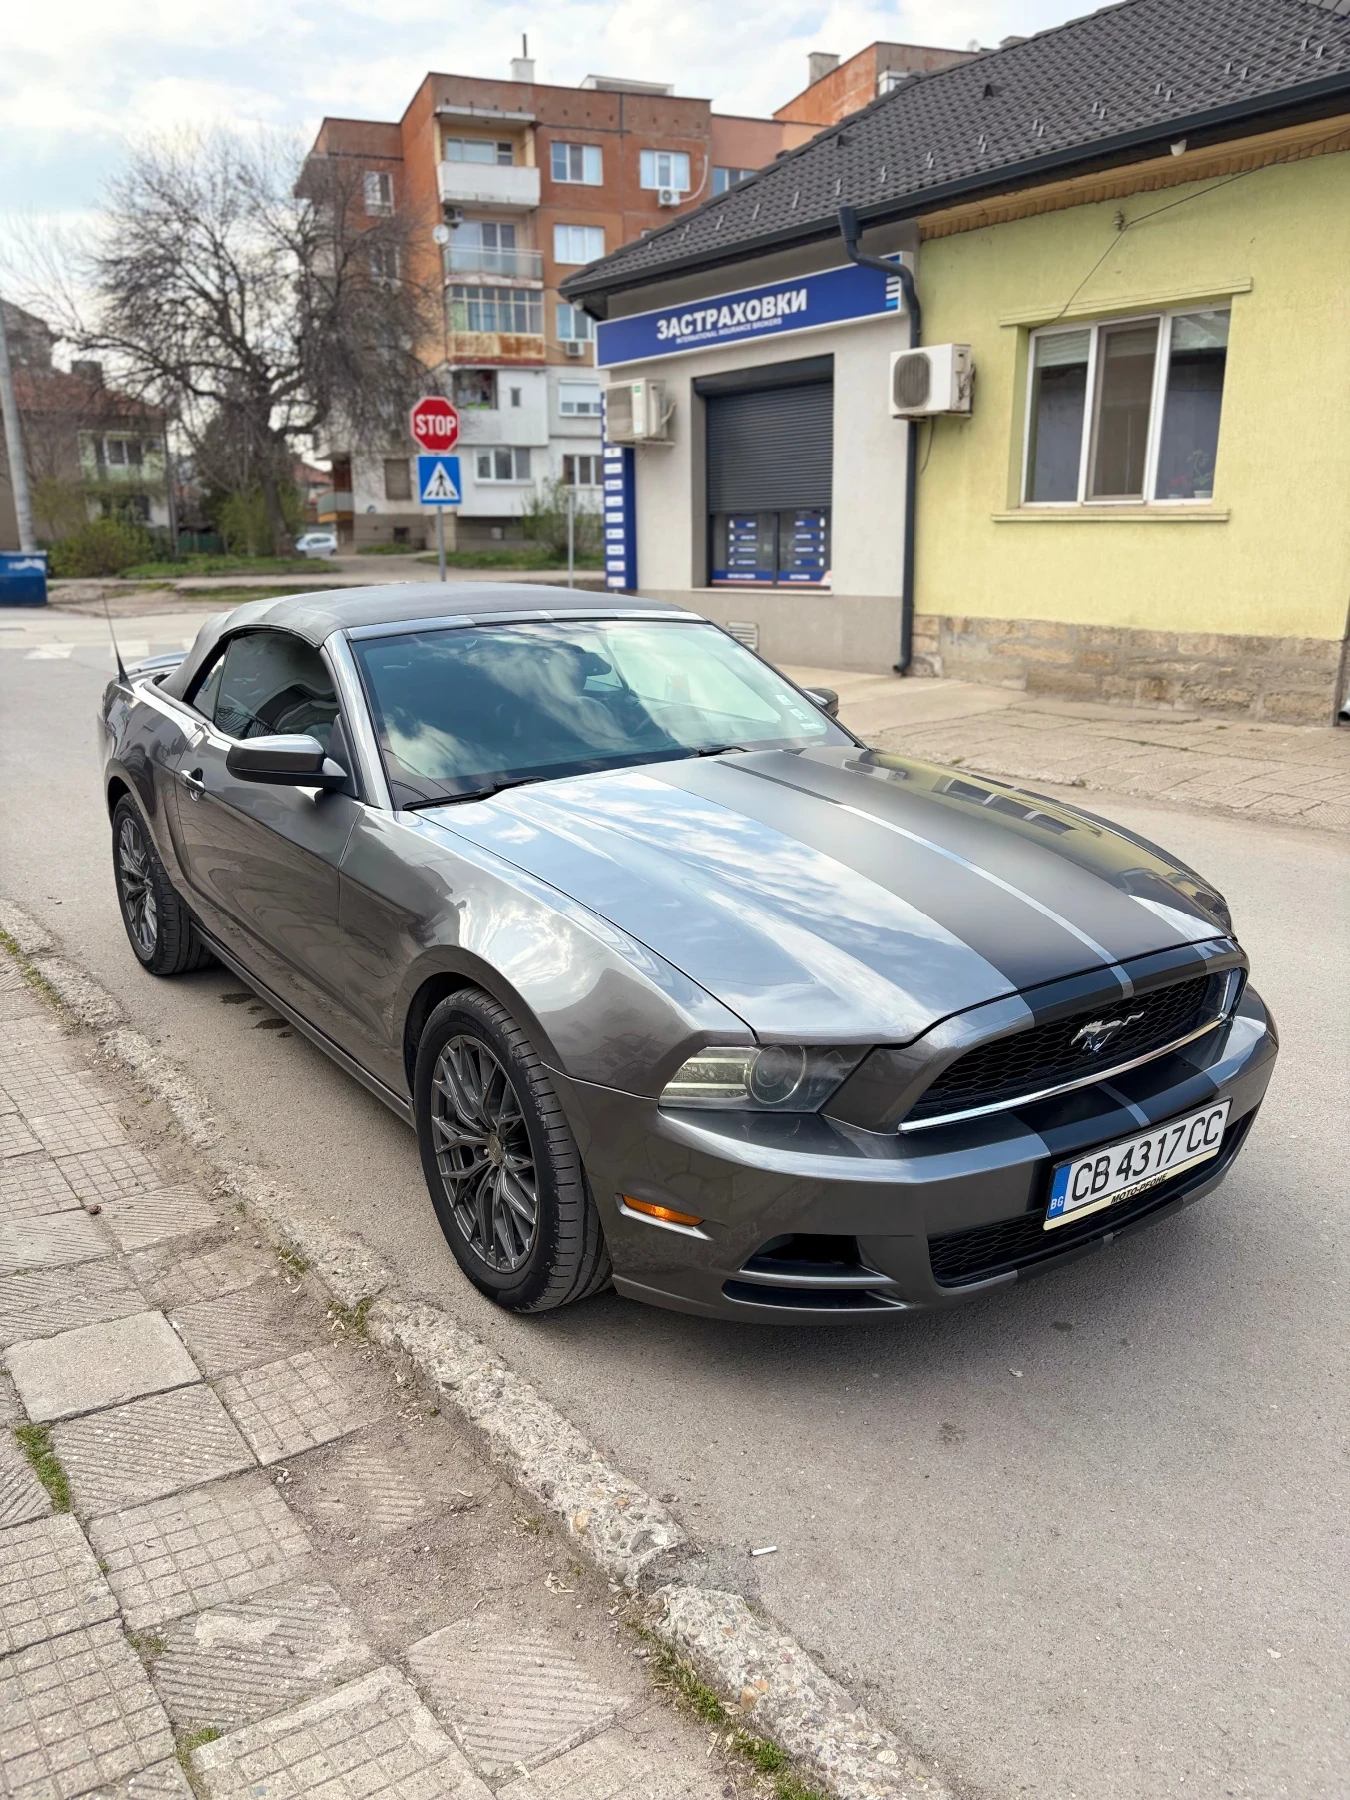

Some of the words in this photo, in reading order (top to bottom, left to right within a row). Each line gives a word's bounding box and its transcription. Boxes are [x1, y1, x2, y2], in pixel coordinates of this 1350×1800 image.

[656, 288, 807, 340] ЗАСТРАХОВКИ
[675, 331, 718, 344] INTERNATIONAL
[718, 323, 751, 336] INSURANCE
[752, 317, 782, 330] BROKERS
[415, 414, 456, 436] STOP
[1115, 1124, 1187, 1182] 4317
[1050, 1195, 1065, 1210] BG
